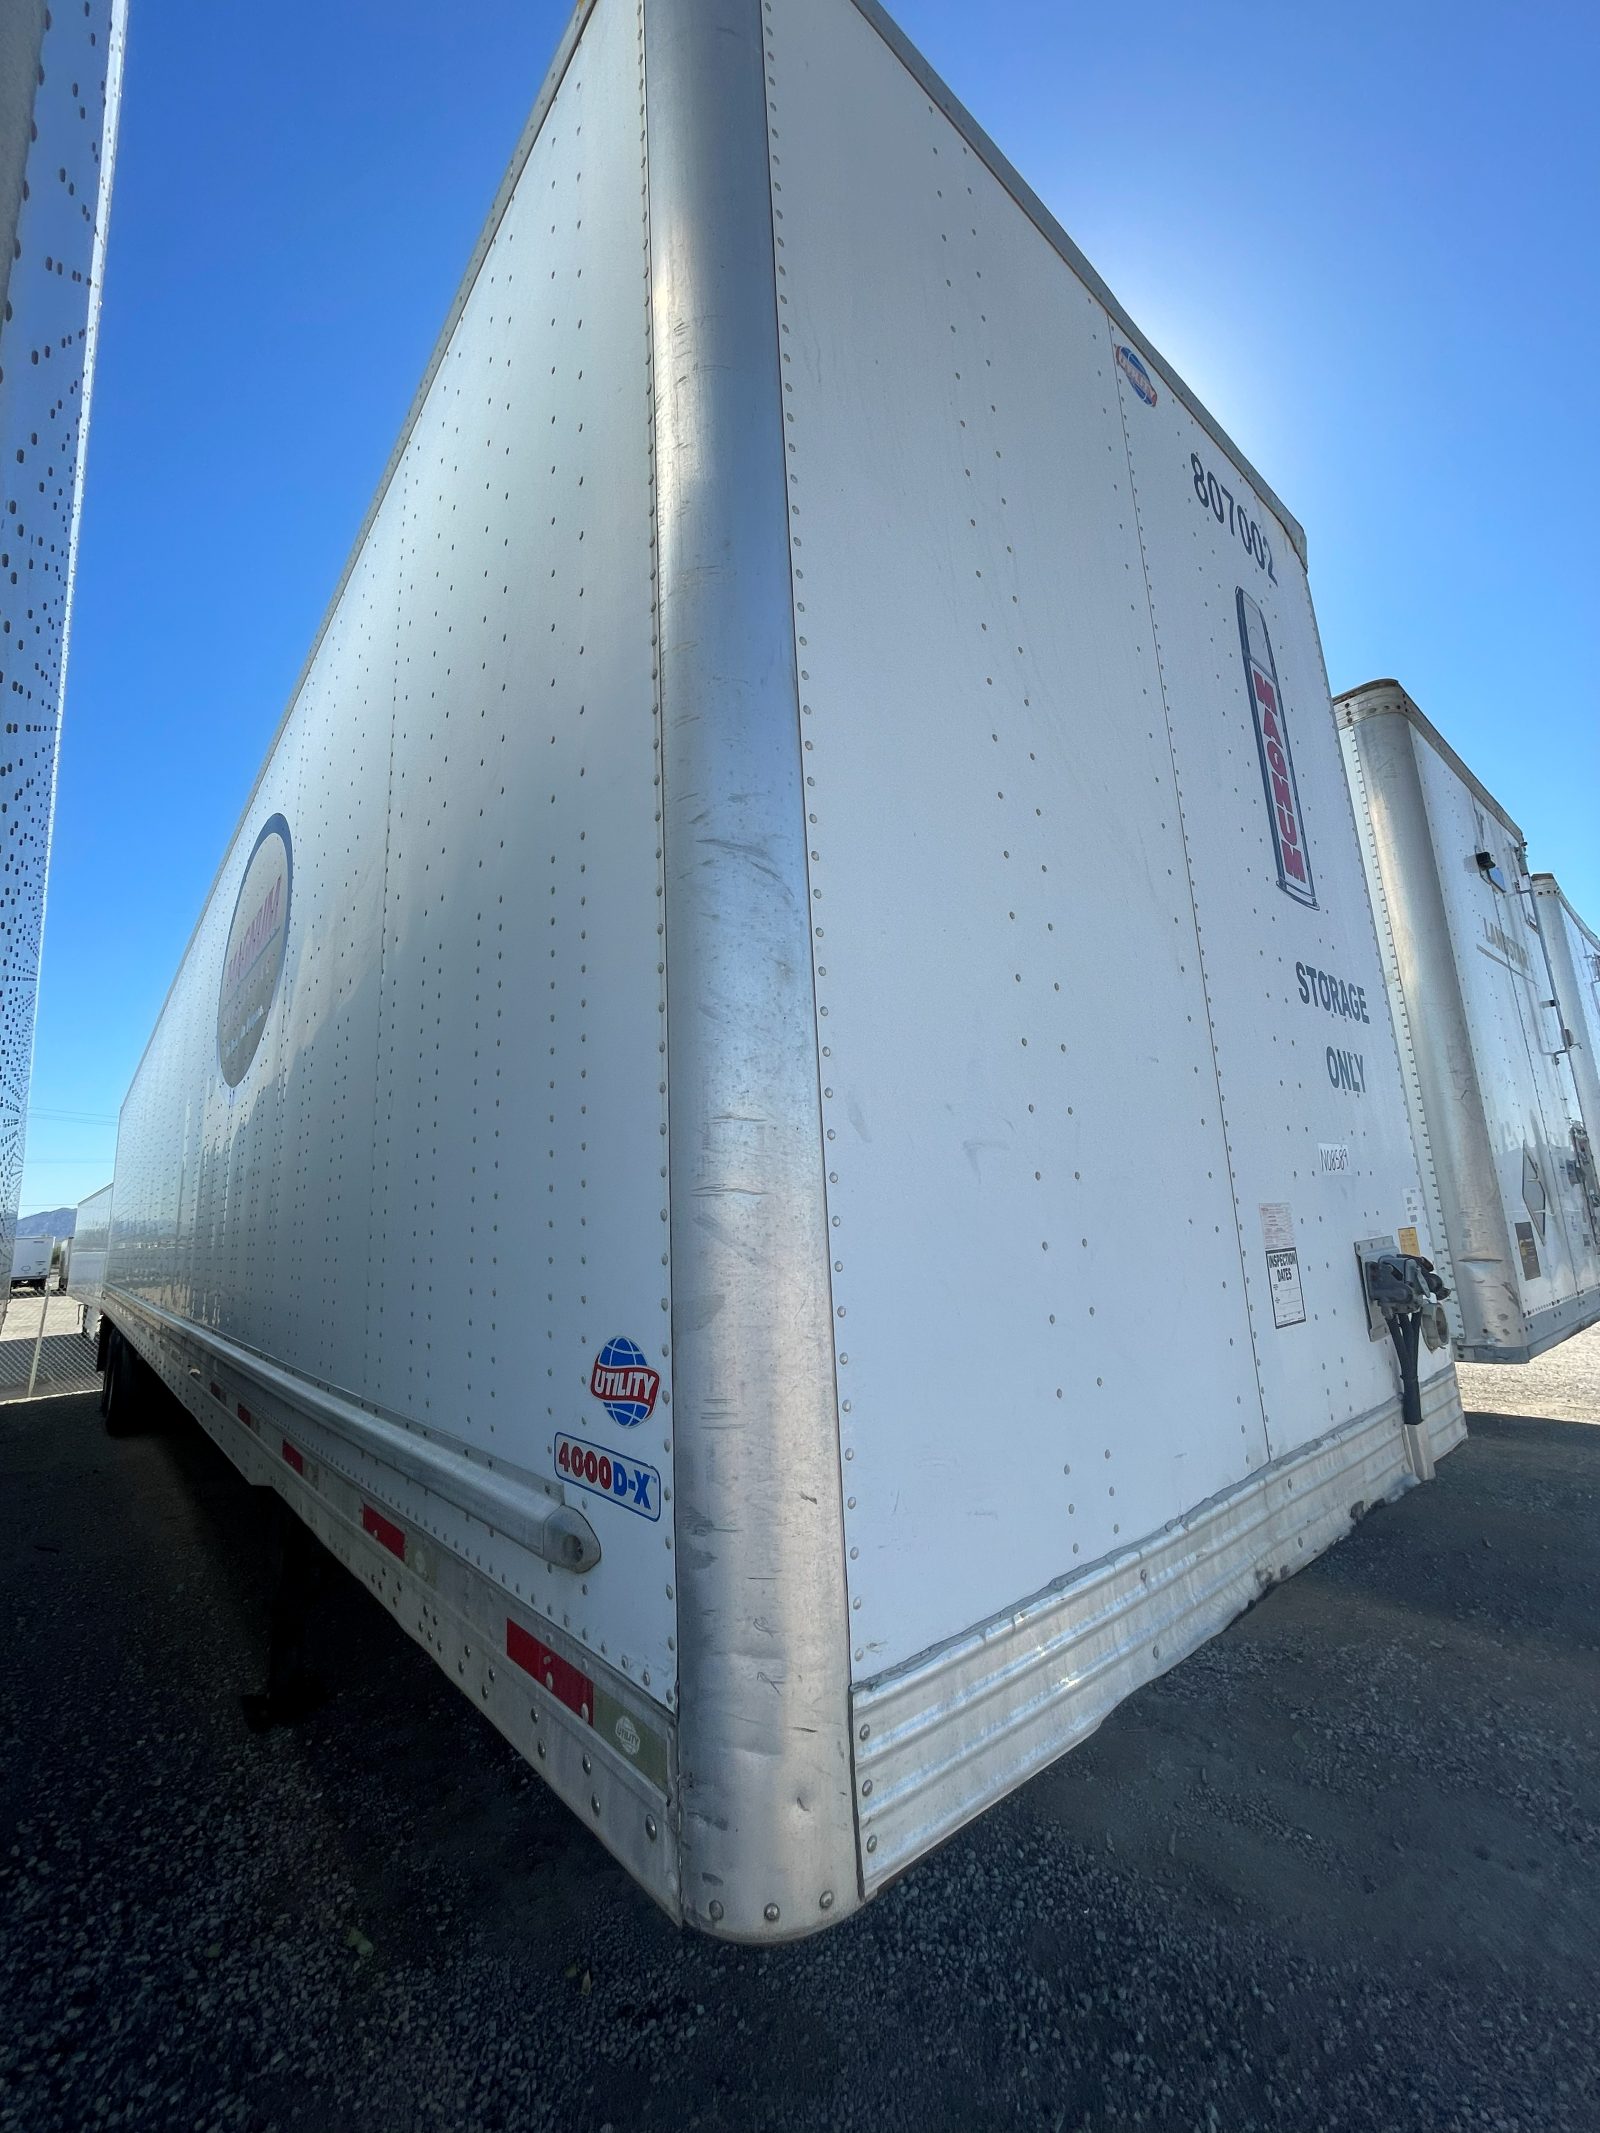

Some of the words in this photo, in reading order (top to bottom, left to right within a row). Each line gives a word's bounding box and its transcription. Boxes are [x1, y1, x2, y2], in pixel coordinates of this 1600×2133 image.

[1190, 453, 1278, 587] 807002
[1253, 669, 1306, 884] MAGNUM
[1296, 961, 1370, 1024] STORAGE
[1326, 1046, 1366, 1093] ONLY
[1268, 1252, 1297, 1268] INSPECTION
[1277, 1267, 1292, 1282] DATES
[594, 1369, 655, 1400] UTILITY
